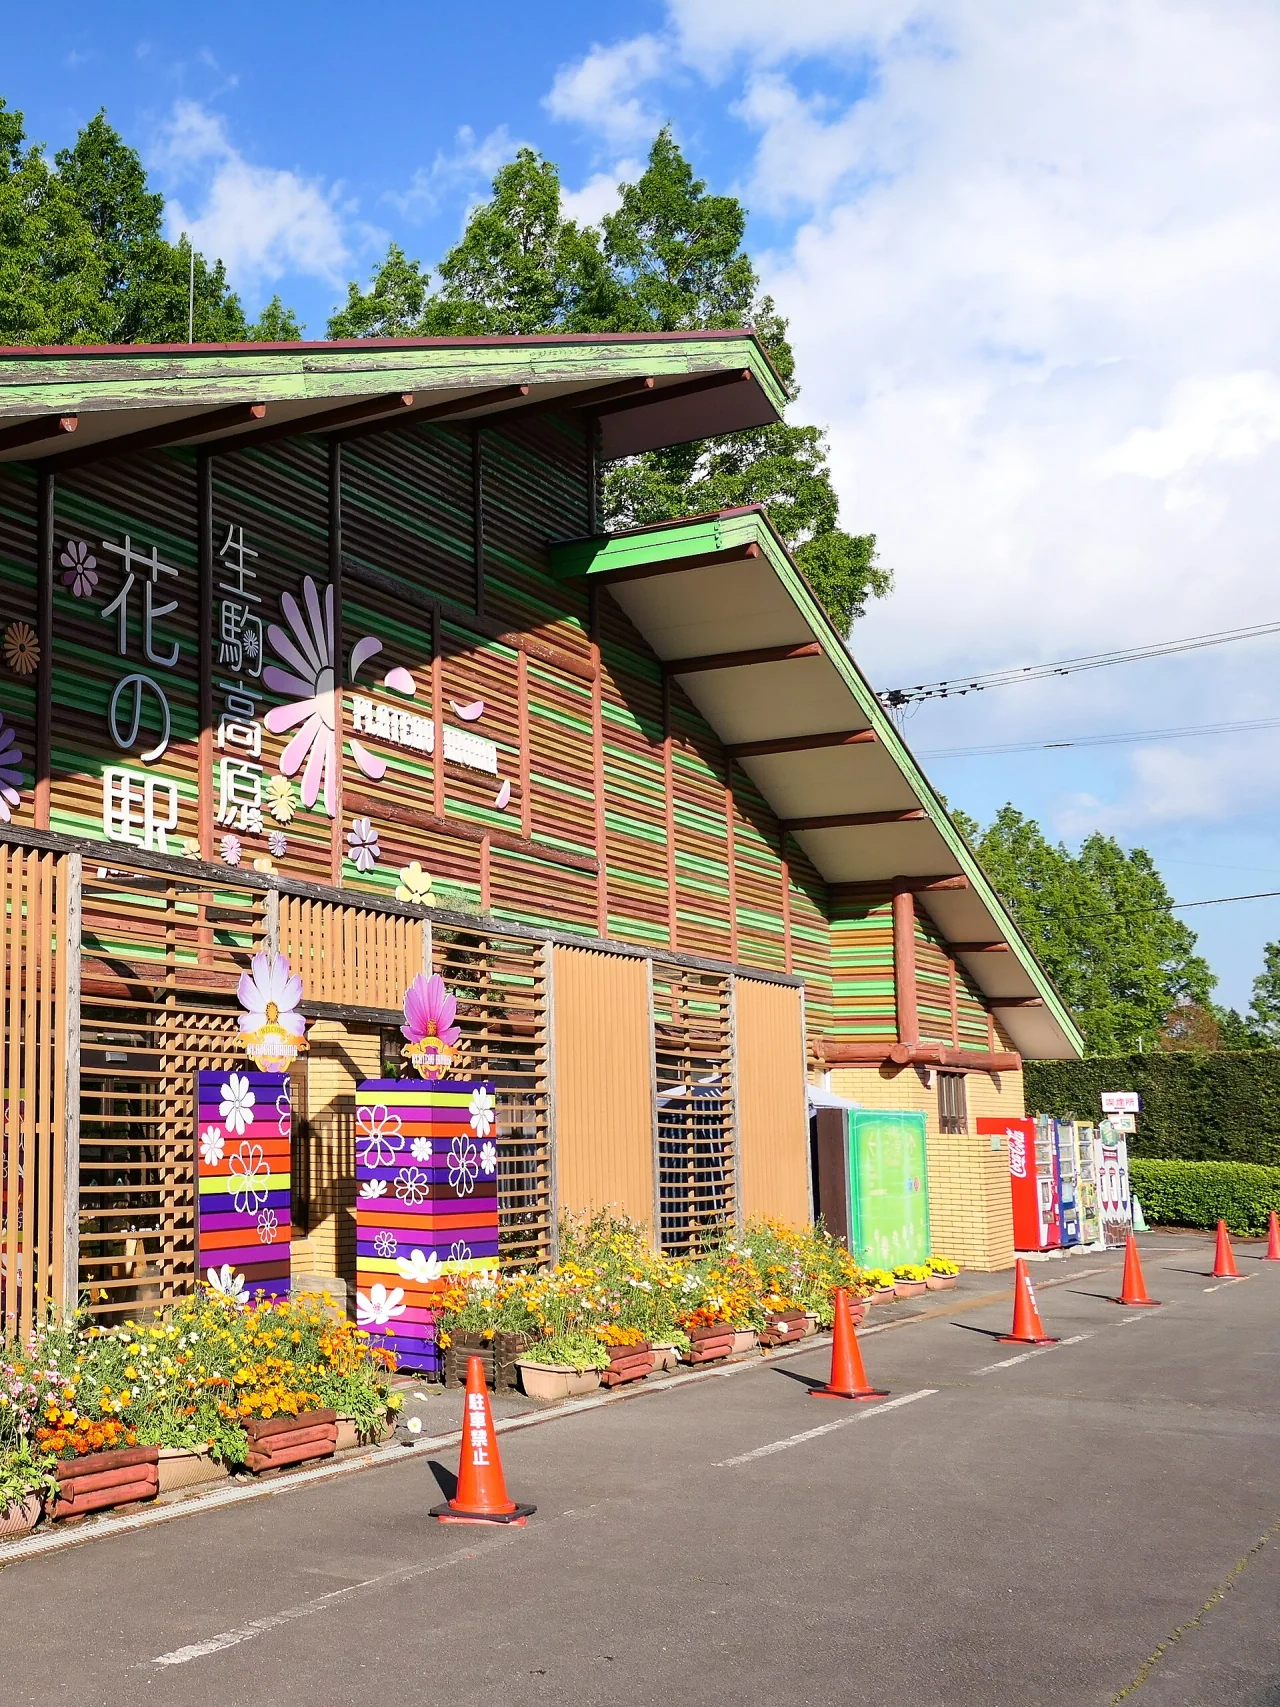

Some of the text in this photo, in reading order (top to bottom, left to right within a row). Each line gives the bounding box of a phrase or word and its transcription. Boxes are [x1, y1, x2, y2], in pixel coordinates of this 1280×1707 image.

[101, 534, 180, 854] 花の駅
[217, 524, 263, 834] 生駒高原
[468, 1393, 490, 1466] 駐車禁止
